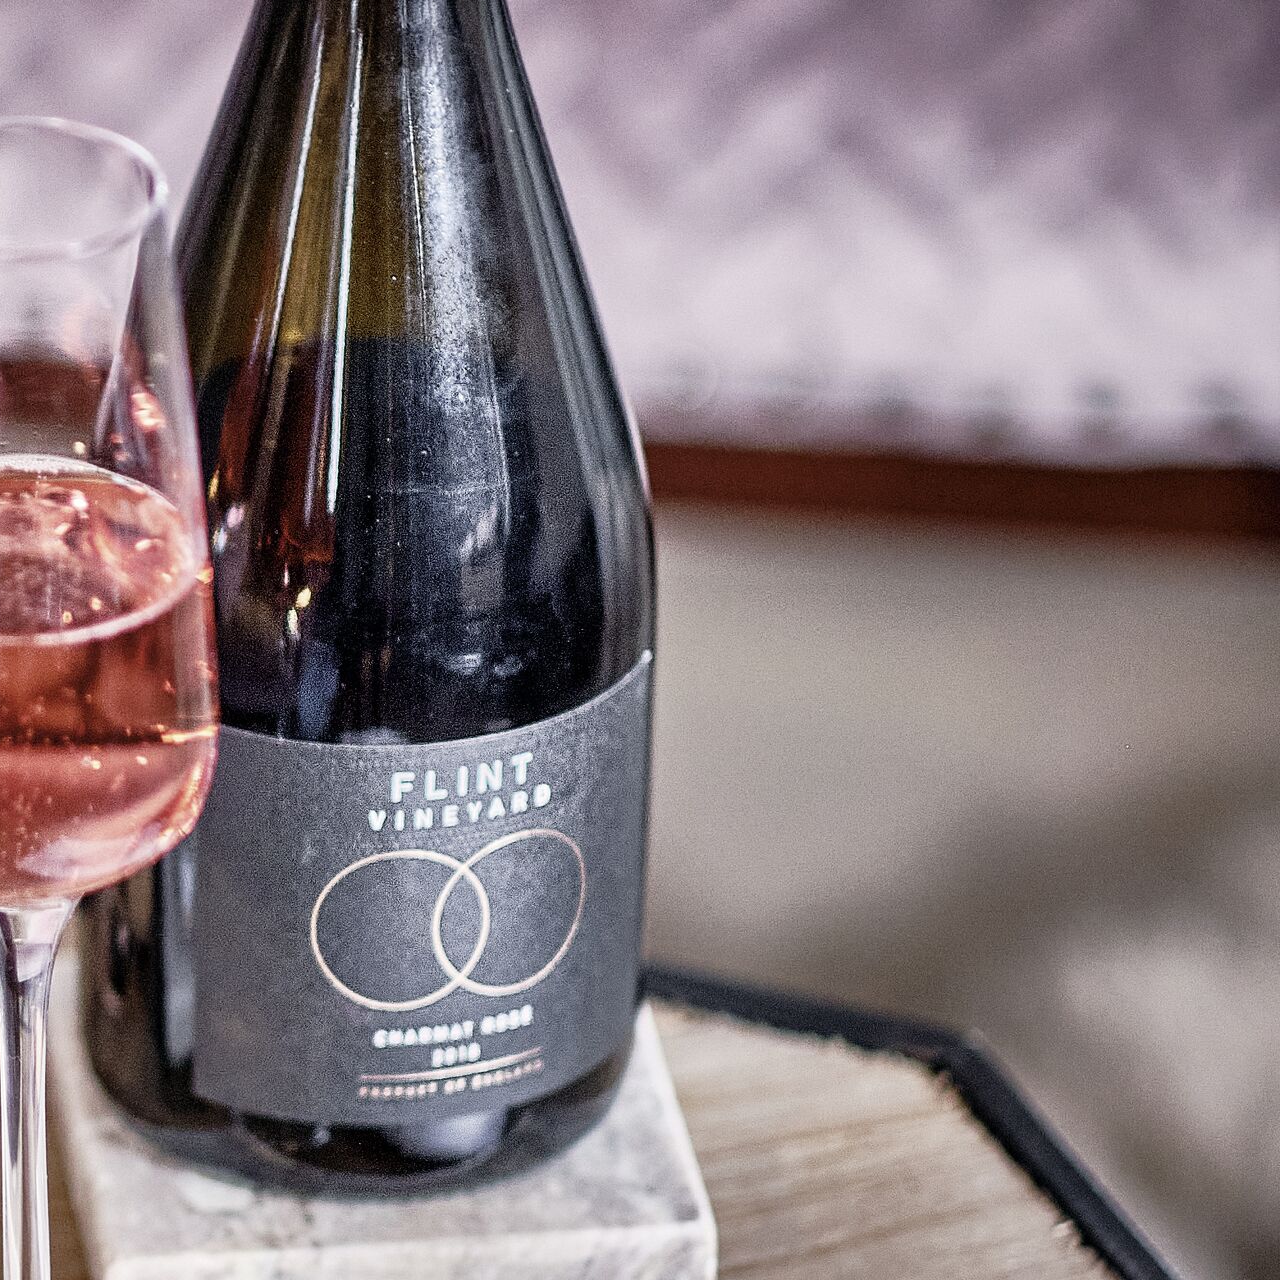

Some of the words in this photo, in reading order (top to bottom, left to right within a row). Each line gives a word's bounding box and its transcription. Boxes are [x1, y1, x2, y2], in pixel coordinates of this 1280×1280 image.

[390, 752, 533, 803] FLINT
[368, 783, 551, 831] VINEYARD
[373, 1020, 475, 1049] CHARMAT
